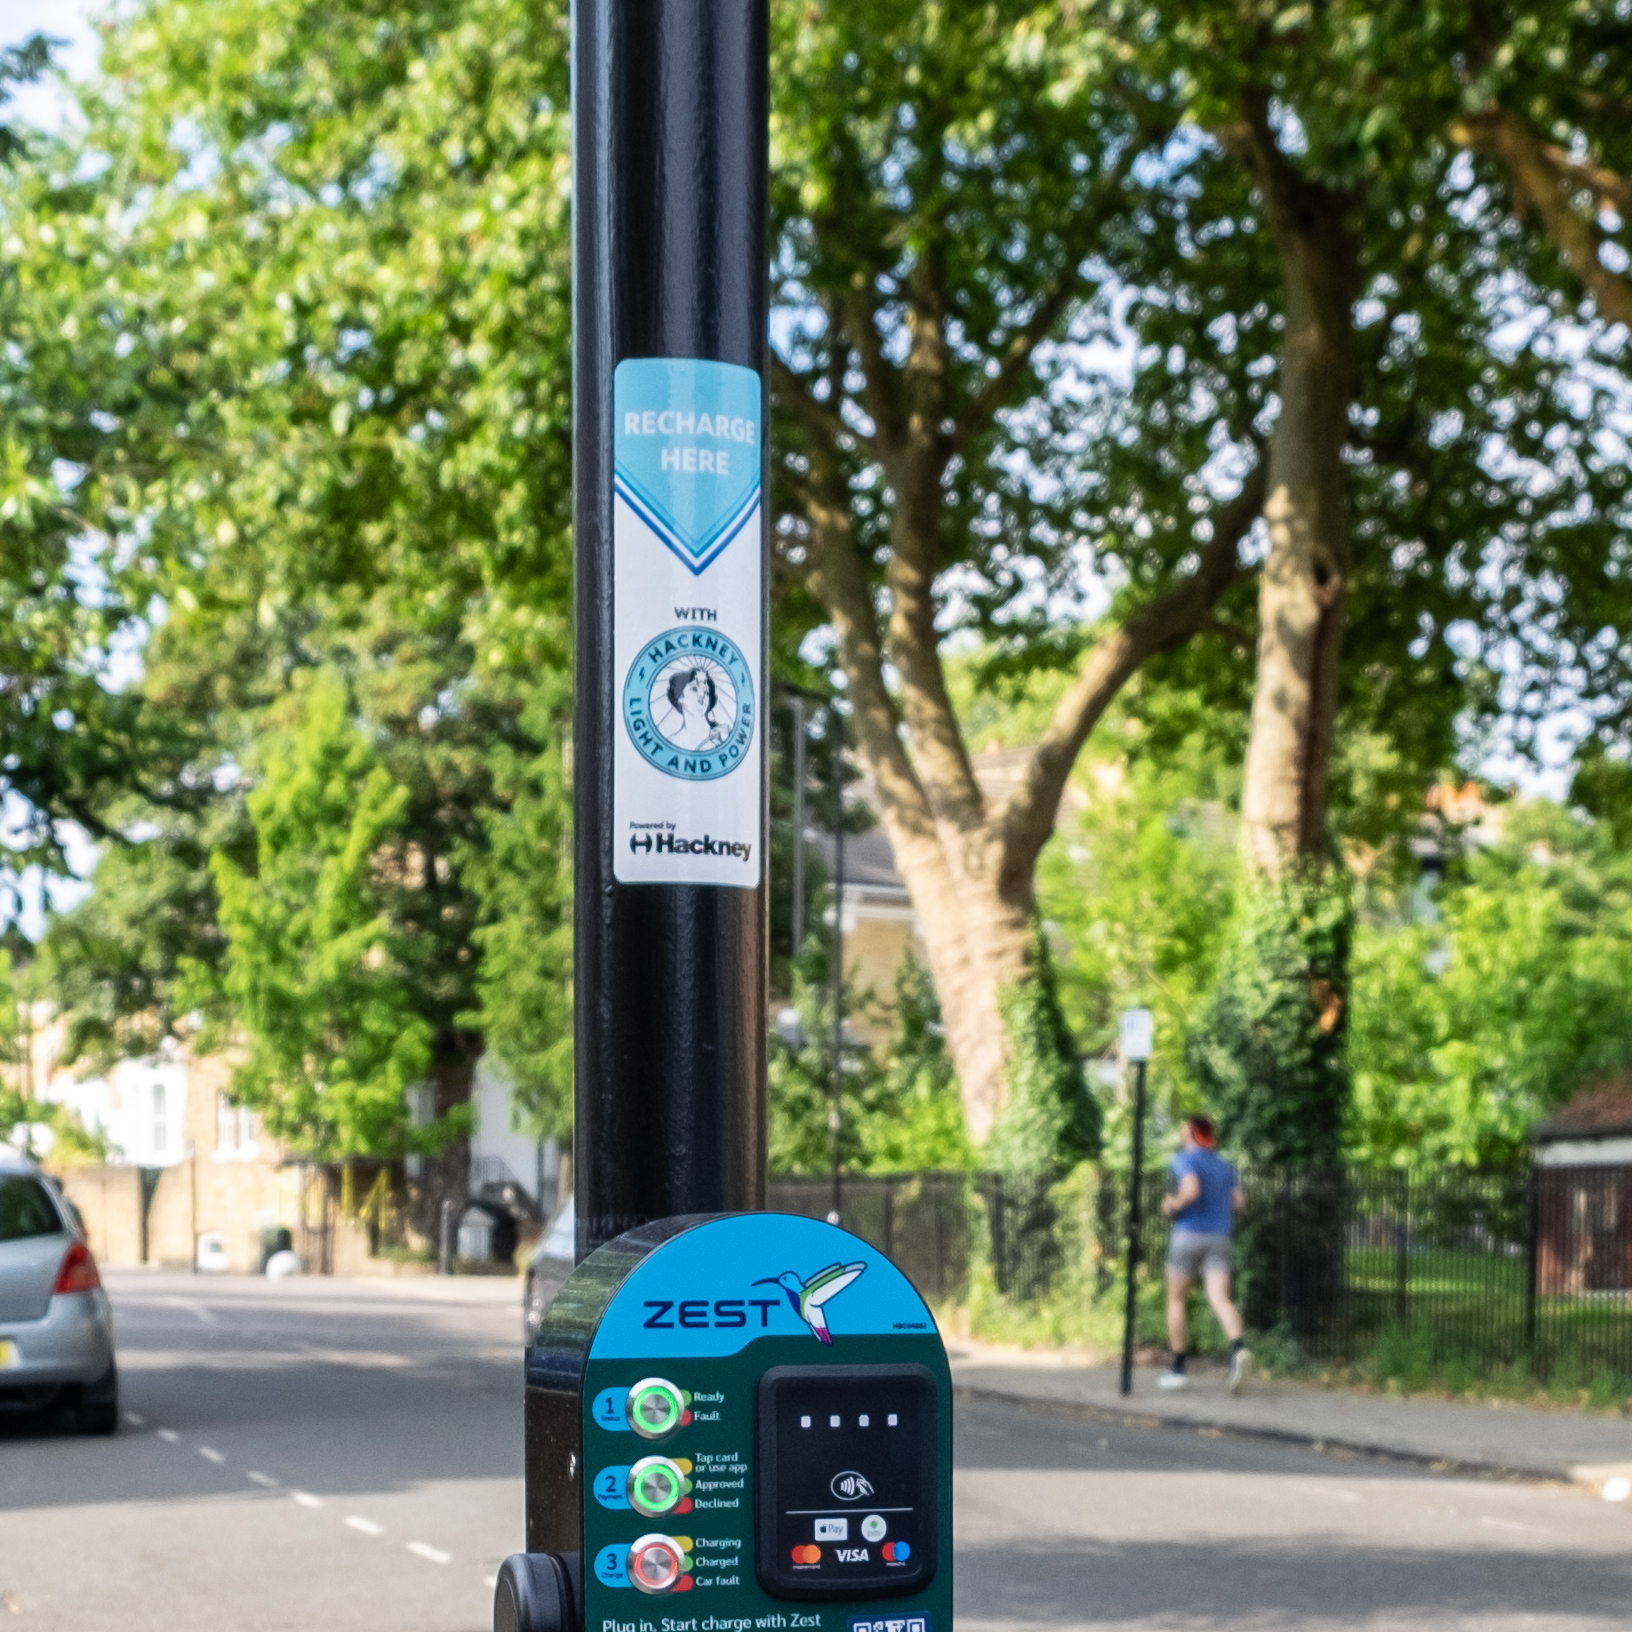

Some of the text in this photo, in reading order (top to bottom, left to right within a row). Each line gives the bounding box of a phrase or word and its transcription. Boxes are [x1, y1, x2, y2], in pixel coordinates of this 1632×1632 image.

[624, 410, 756, 445] RECHARGE
[661, 446, 730, 475] HERE
[674, 606, 718, 622] WITH
[648, 633, 739, 664] HACKNEY
[629, 697, 752, 773] LIGHT AND POWER
[629, 820, 676, 831] Powered by
[655, 832, 752, 862] Hackney
[643, 1299, 781, 1329] ZEST
[694, 1392, 724, 1403] Ready
[605, 1397, 615, 1415] 1
[694, 1411, 720, 1421] Fault
[695, 1451, 738, 1464] Tap card
[695, 1463, 748, 1474] or use app
[605, 1475, 617, 1492] 2
[695, 1478, 744, 1492] Approved
[694, 1498, 739, 1508] Declined
[828, 1524, 844, 1535] Pay
[695, 1538, 741, 1549] Charging
[606, 1553, 617, 1570] 3
[695, 1557, 739, 1567] Charged
[835, 1549, 869, 1563] VISA
[695, 1575, 740, 1586] Car fault
[639, 1618, 657, 1632] in.
[661, 1617, 698, 1632] Start
[701, 1616, 752, 1632] charge
[755, 1613, 787, 1628] with
[790, 1613, 822, 1628] Zest
